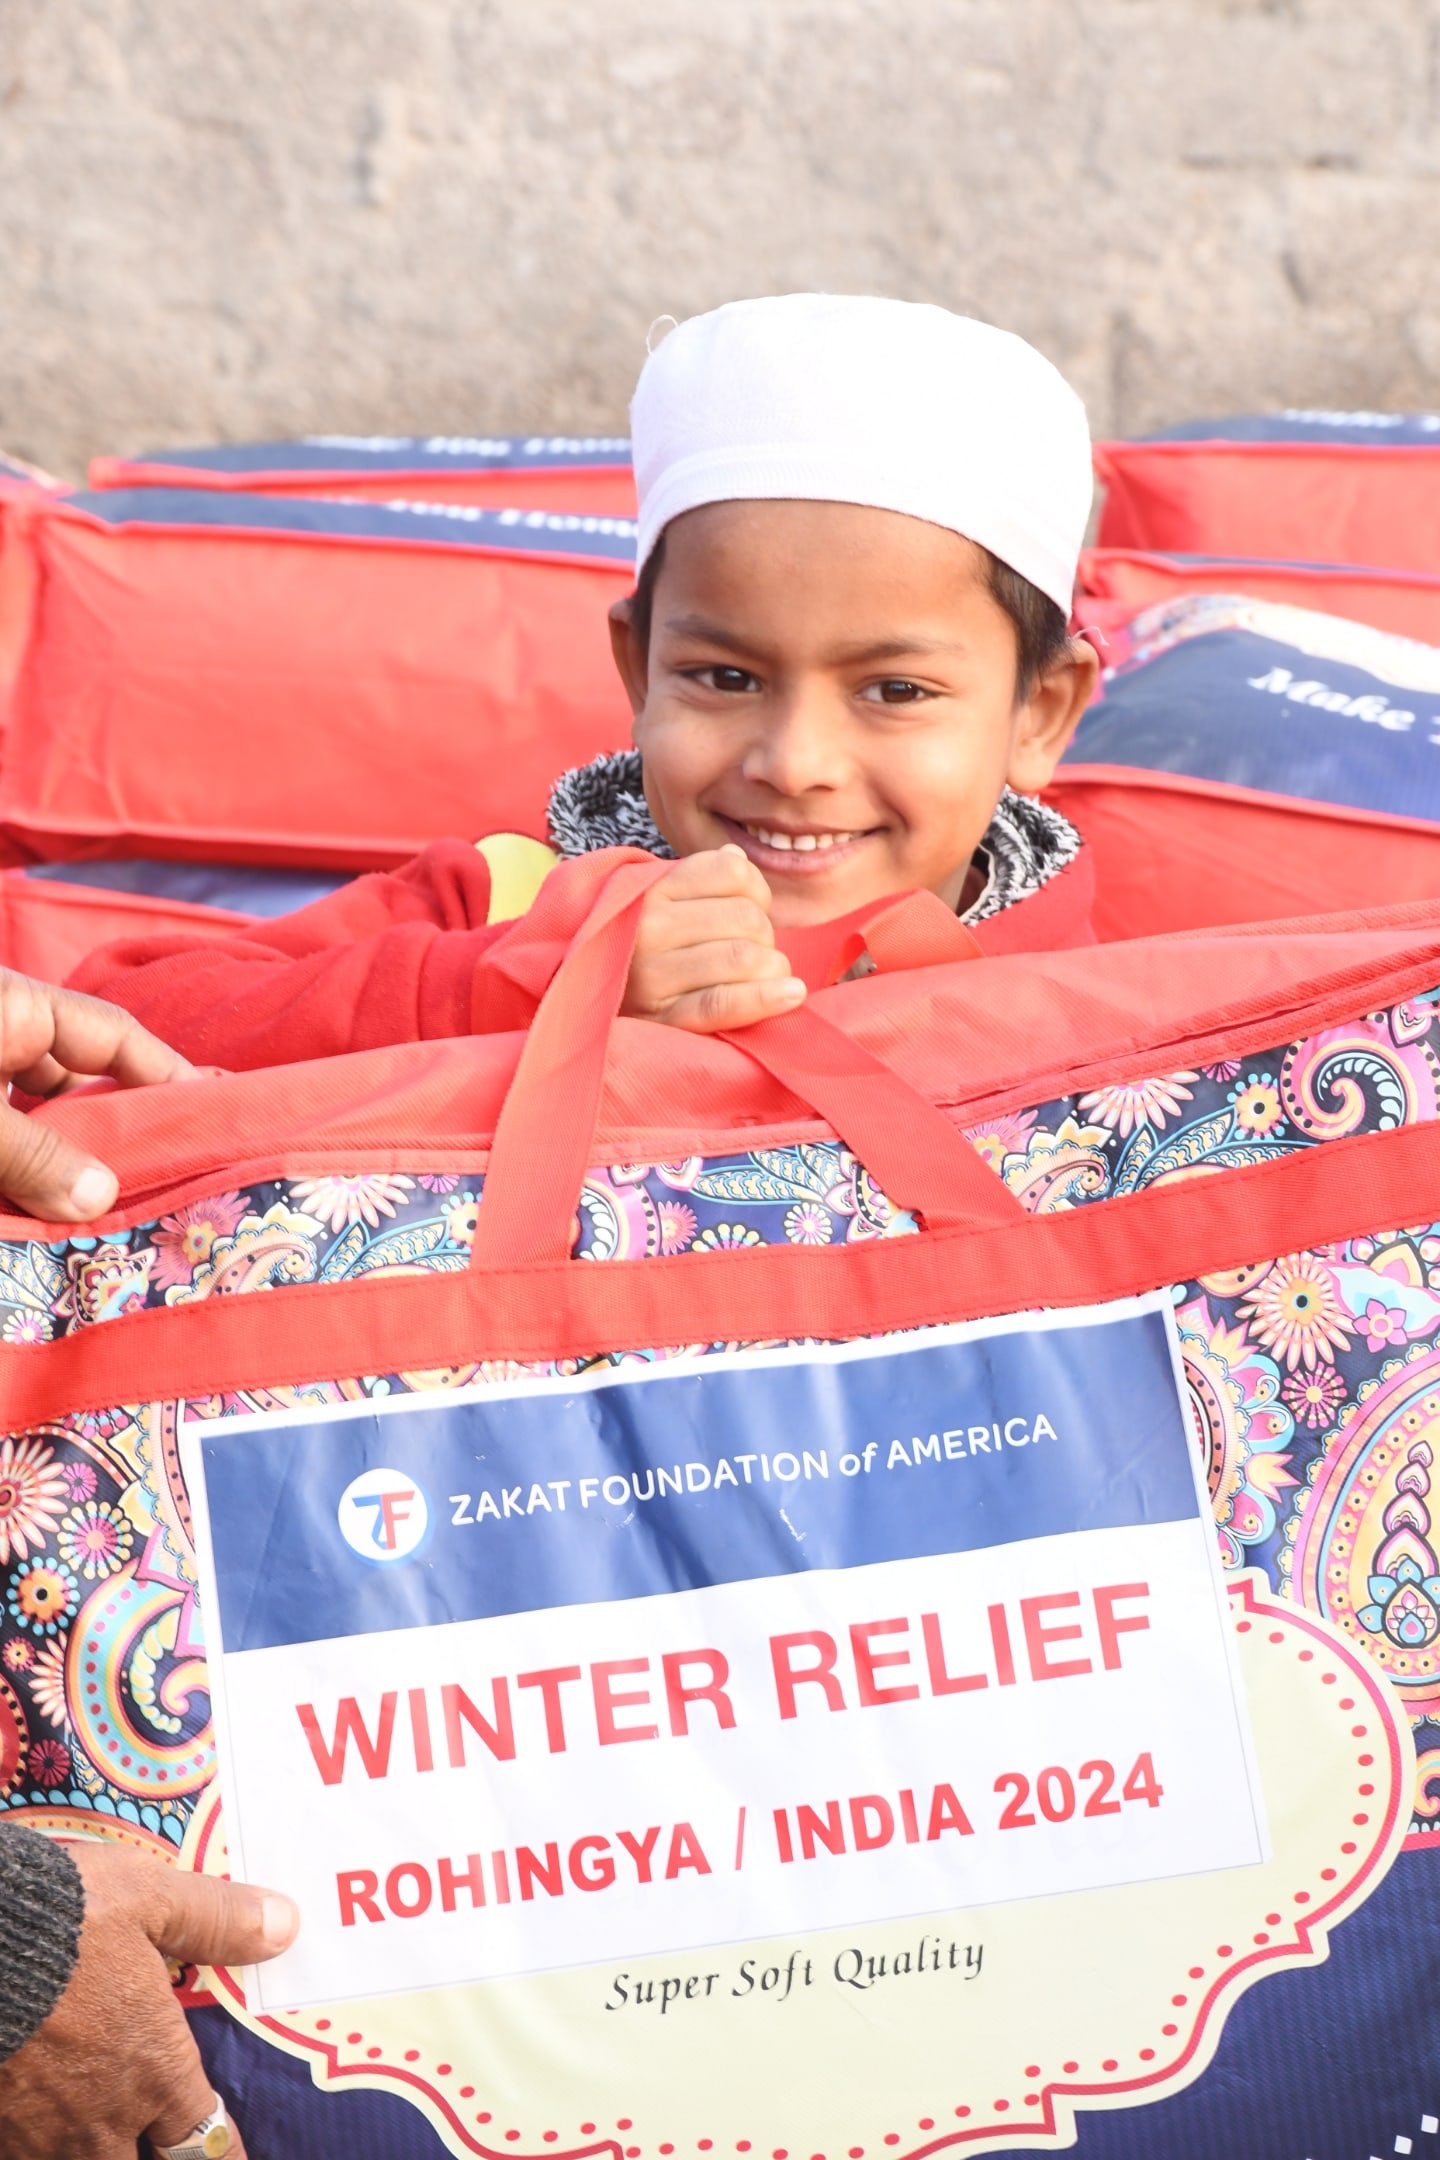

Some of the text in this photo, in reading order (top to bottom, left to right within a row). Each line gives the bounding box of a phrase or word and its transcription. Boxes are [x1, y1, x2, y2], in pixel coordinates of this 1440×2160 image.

[1246, 666, 1417, 731] Make
[448, 1413, 1059, 1526] ZAKAT FOUNDATION of AMERICA
[296, 1582, 1150, 1785] WINTER RELIEF
[335, 1751, 1164, 1927] ROHINGYA / INDIA 2024
[605, 1935, 985, 2014] Super Soft Quality
